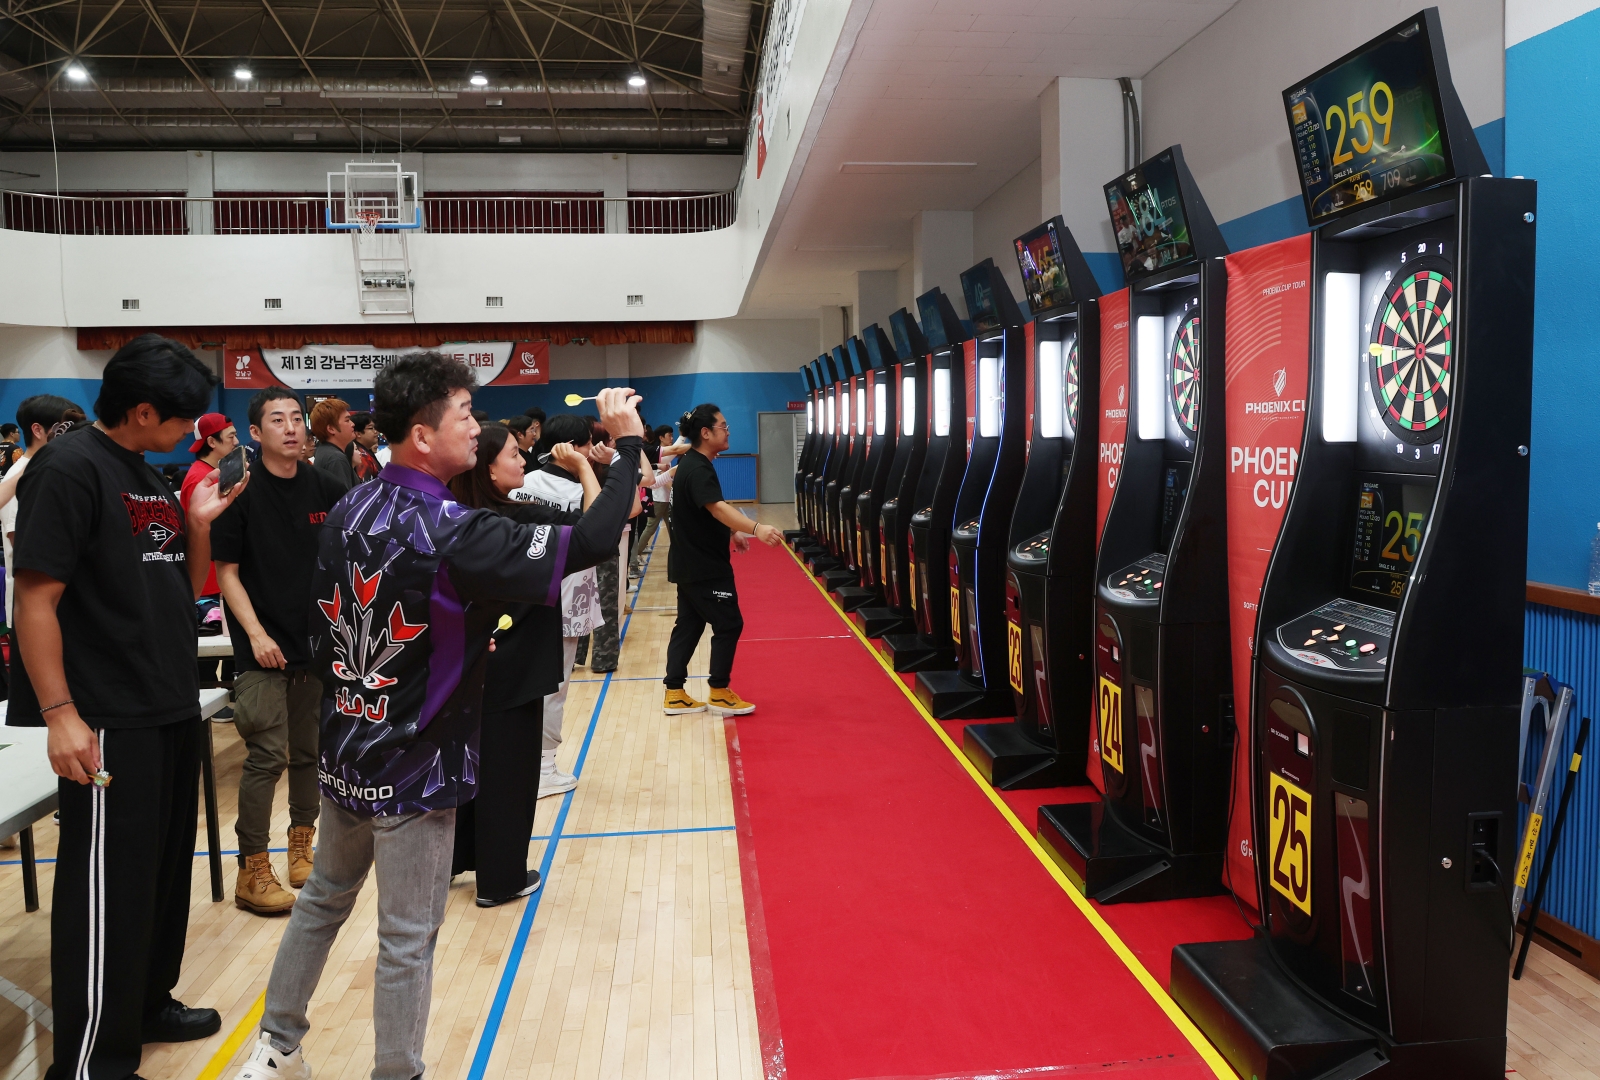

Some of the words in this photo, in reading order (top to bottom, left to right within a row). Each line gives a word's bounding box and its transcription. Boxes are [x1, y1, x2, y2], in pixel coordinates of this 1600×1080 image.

[1325, 81, 1394, 166] 259
[1380, 168, 1400, 190] 709
[1418, 242, 1426, 254] 20
[1438, 242, 1443, 254] 1
[1401, 252, 1406, 263] 5
[1384, 270, 1391, 280] 12
[1282, 283, 1291, 292] CUP
[1292, 280, 1306, 289] TOUR
[1374, 295, 1378, 304] 9
[281, 355, 316, 370] 제1회
[469, 353, 494, 368] 대회
[1246, 400, 1290, 414] PHOENIX
[1106, 409, 1127, 418] PHOENIX
[1382, 429, 1387, 440] 7
[1396, 443, 1404, 454] 19
[1415, 448, 1420, 460] 3
[1432, 443, 1440, 454] 17
[516, 492, 532, 502] PARK
[1009, 627, 1021, 689] 23
[1102, 684, 1121, 766] 24
[1273, 784, 1308, 903] 25
